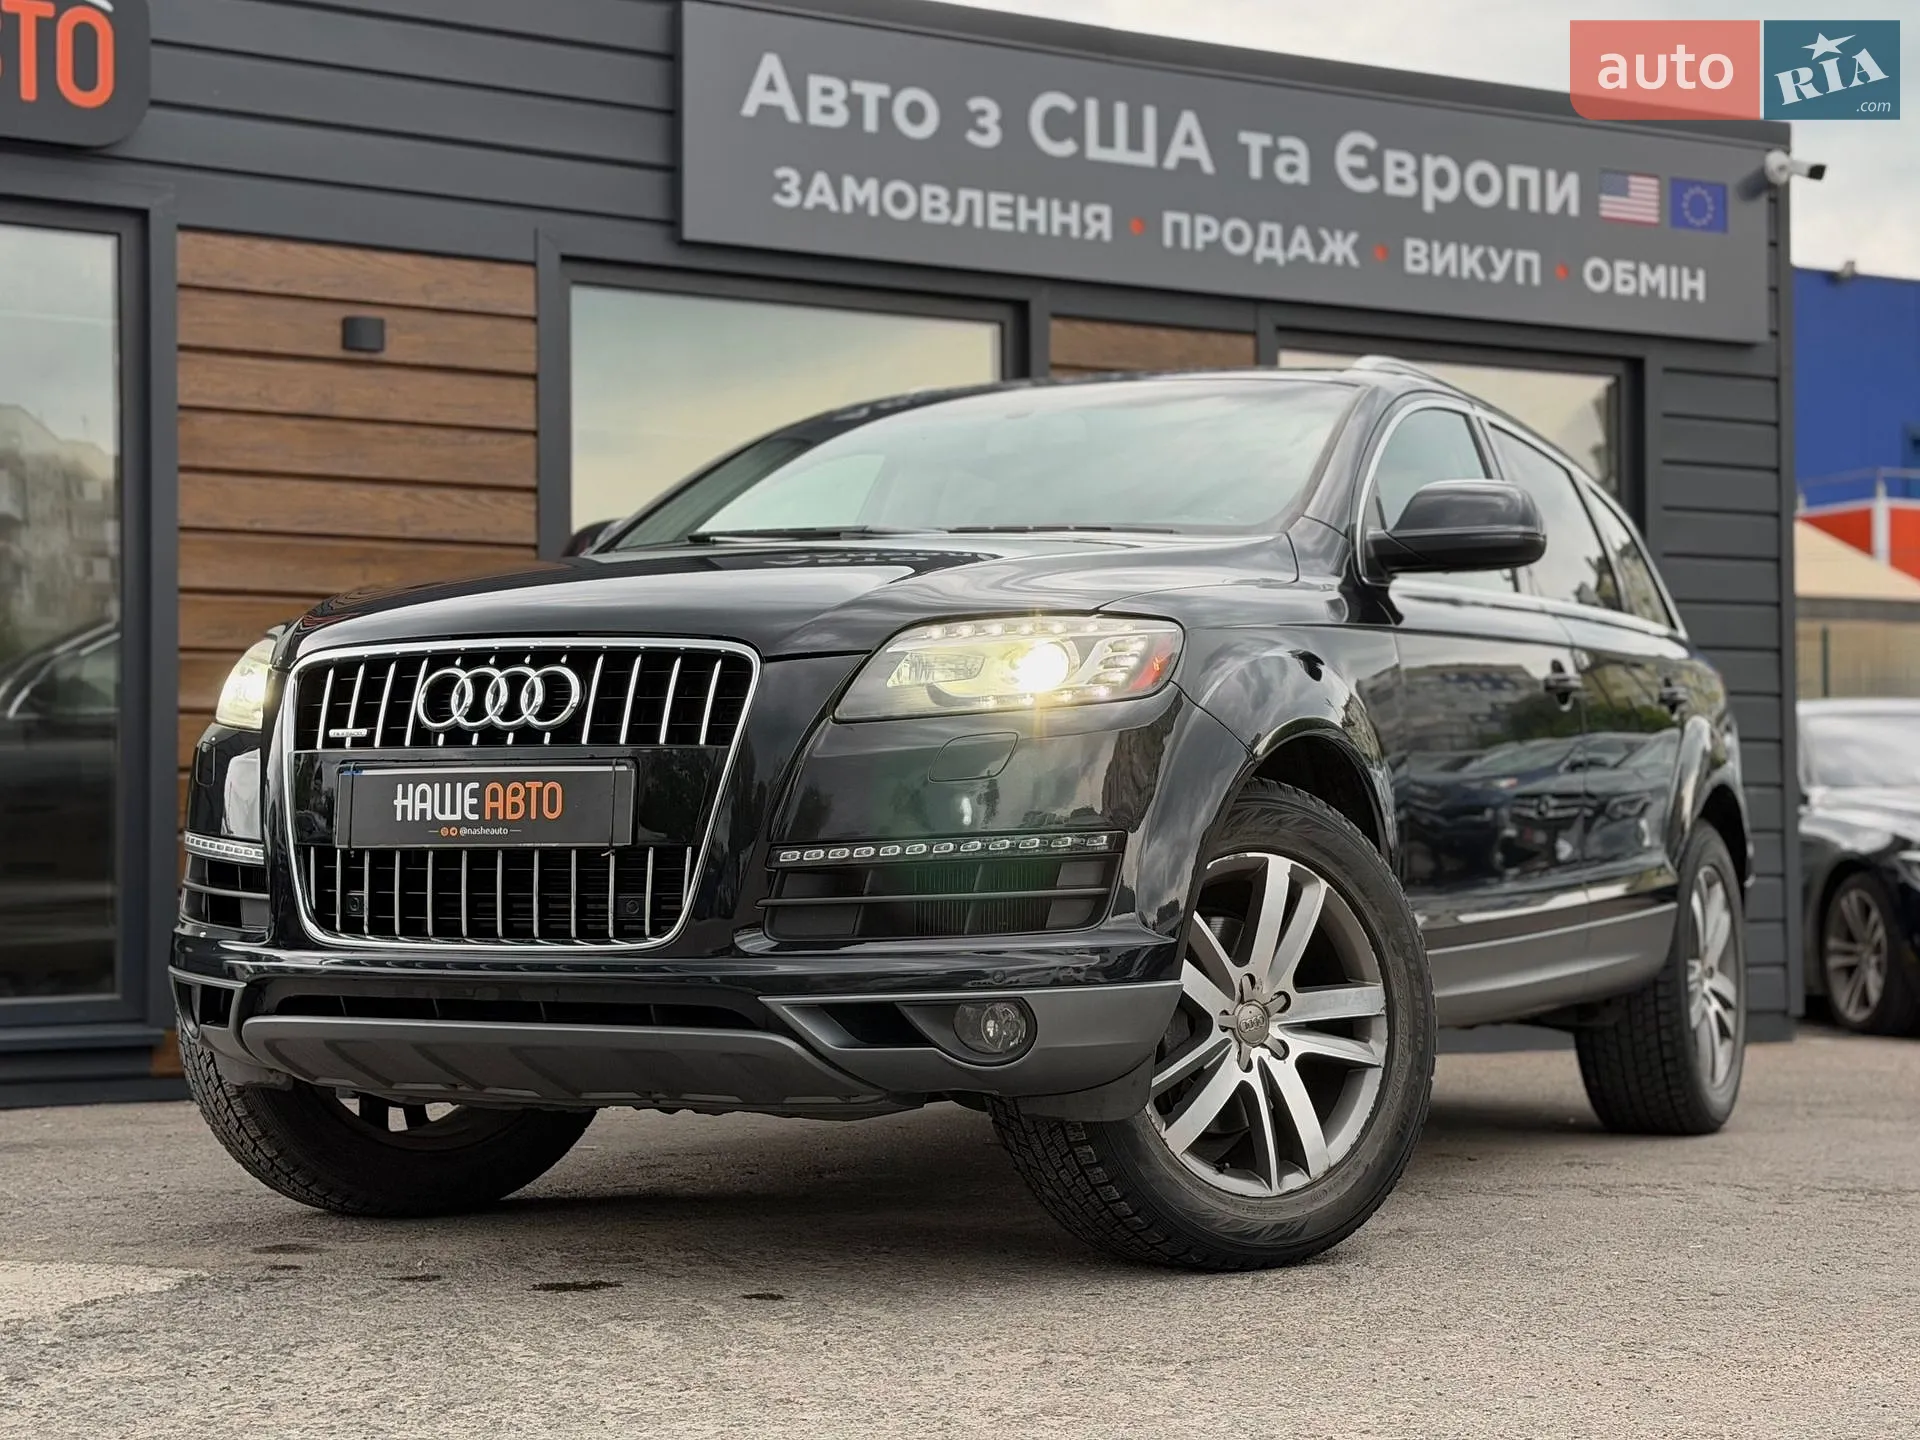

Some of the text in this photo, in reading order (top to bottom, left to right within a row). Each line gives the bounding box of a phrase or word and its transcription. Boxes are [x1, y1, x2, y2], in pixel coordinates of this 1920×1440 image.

[0, 0, 115, 109] ТО
[1028, 91, 1215, 174] США
[1238, 131, 1310, 185] та
[1334, 131, 1580, 217] Європи
[772, 166, 1706, 303] ЗАМОВЛЕННЯ ПРОДАЖ ВИКУП ОБМІН
[393, 781, 563, 821] НАШЕ АВТО
[459, 826, 509, 837] @nasheauto
